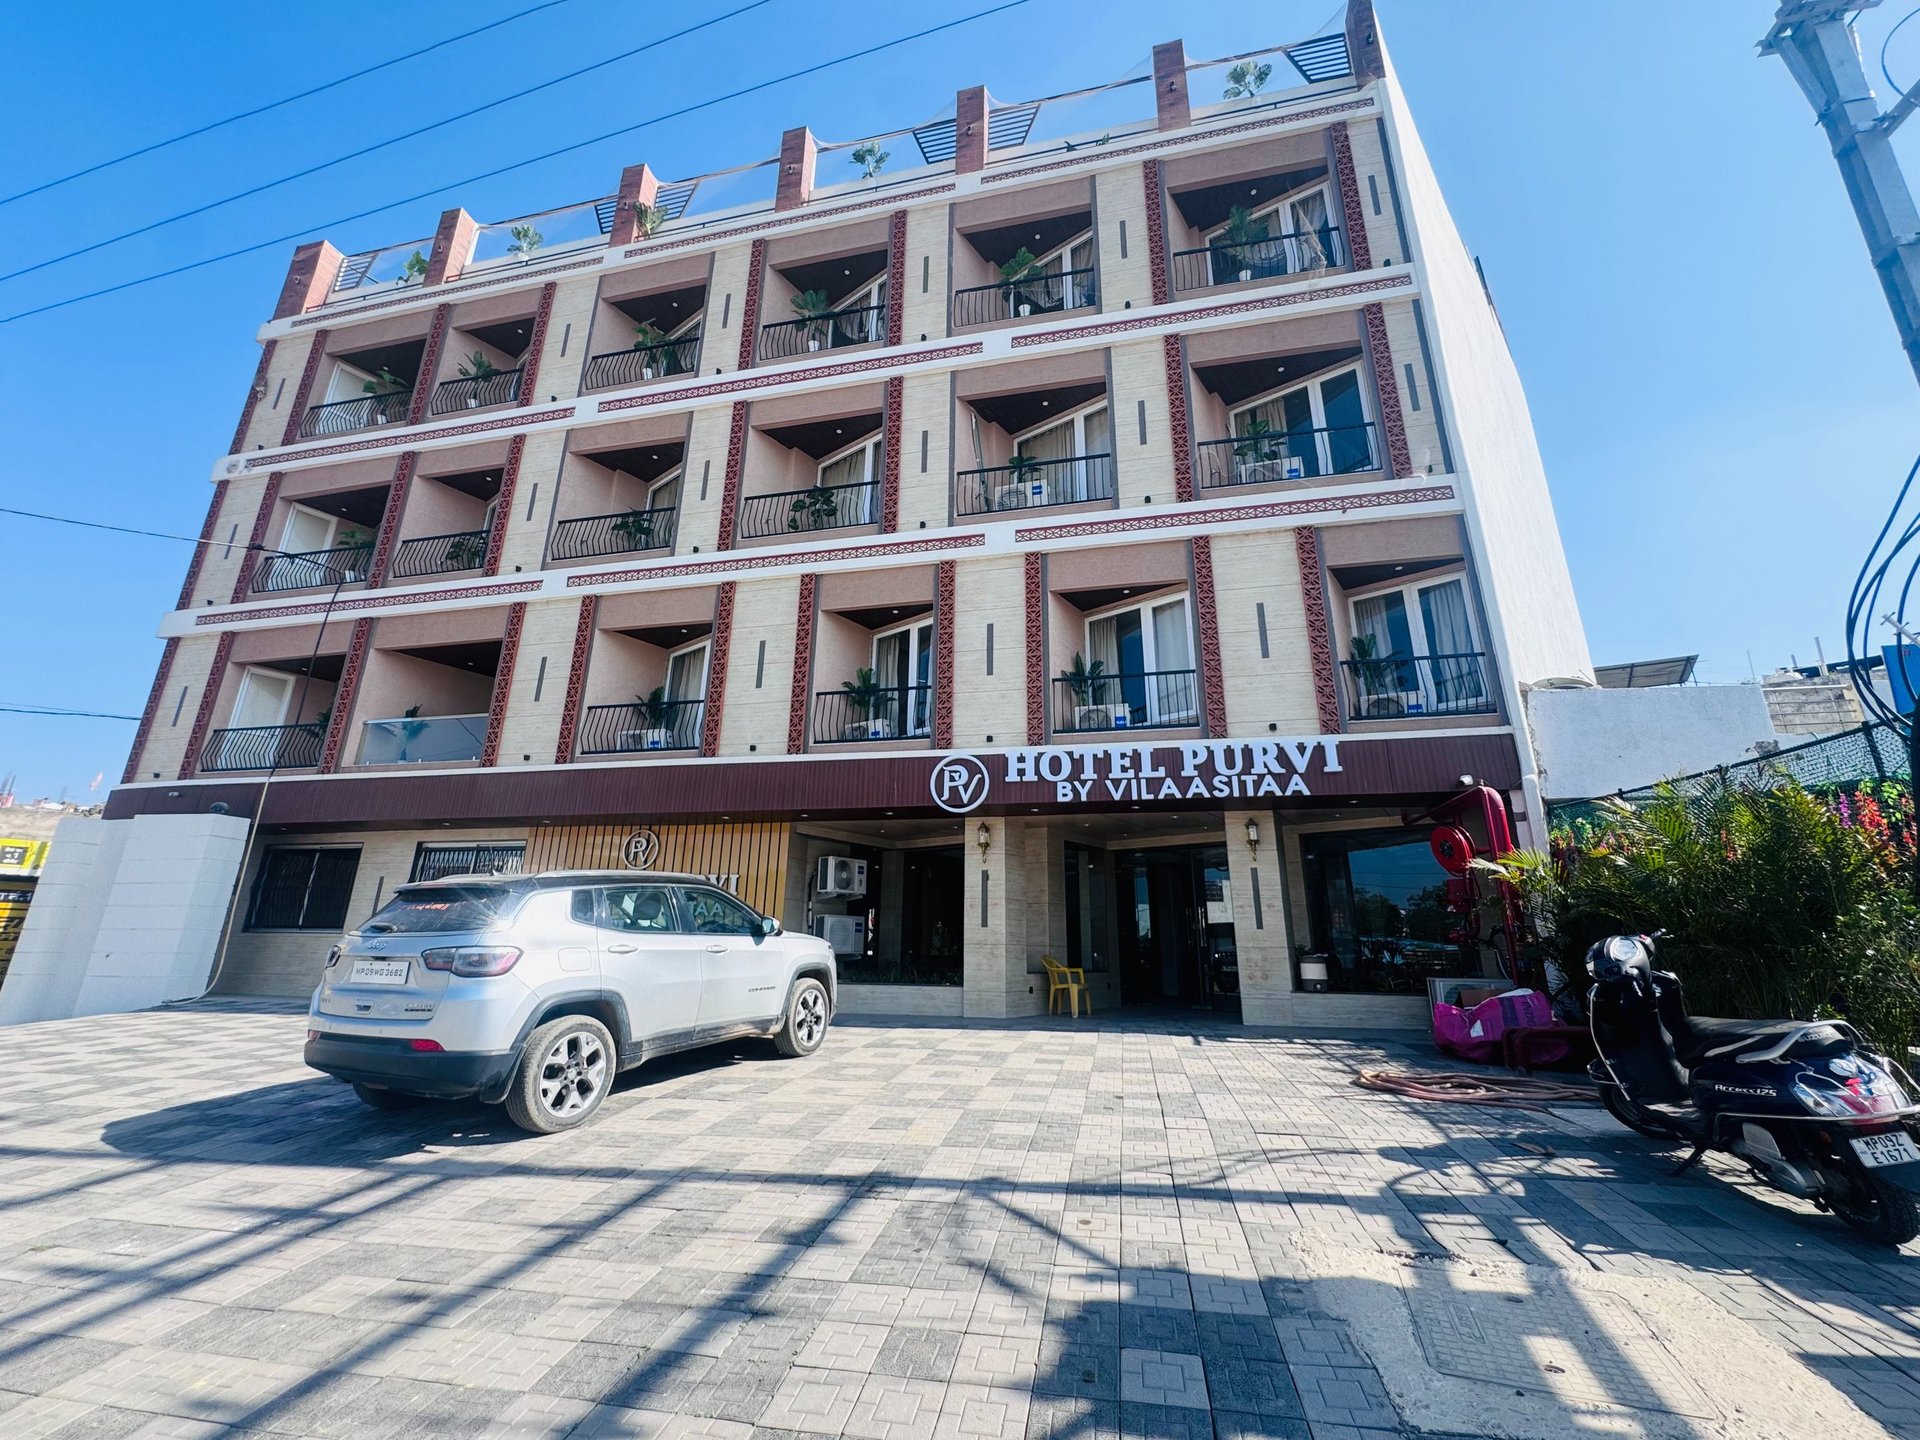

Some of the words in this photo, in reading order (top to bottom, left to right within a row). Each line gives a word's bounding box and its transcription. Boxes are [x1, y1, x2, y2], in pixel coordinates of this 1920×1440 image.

[1004, 745, 1166, 783] HOTEL
[1179, 738, 1344, 775] PURVI
[1056, 780, 1093, 803] BY
[1104, 773, 1312, 801] VILAASITAA
[1862, 1134, 1905, 1151] MP09Z
[1870, 1148, 1915, 1165] E1671
